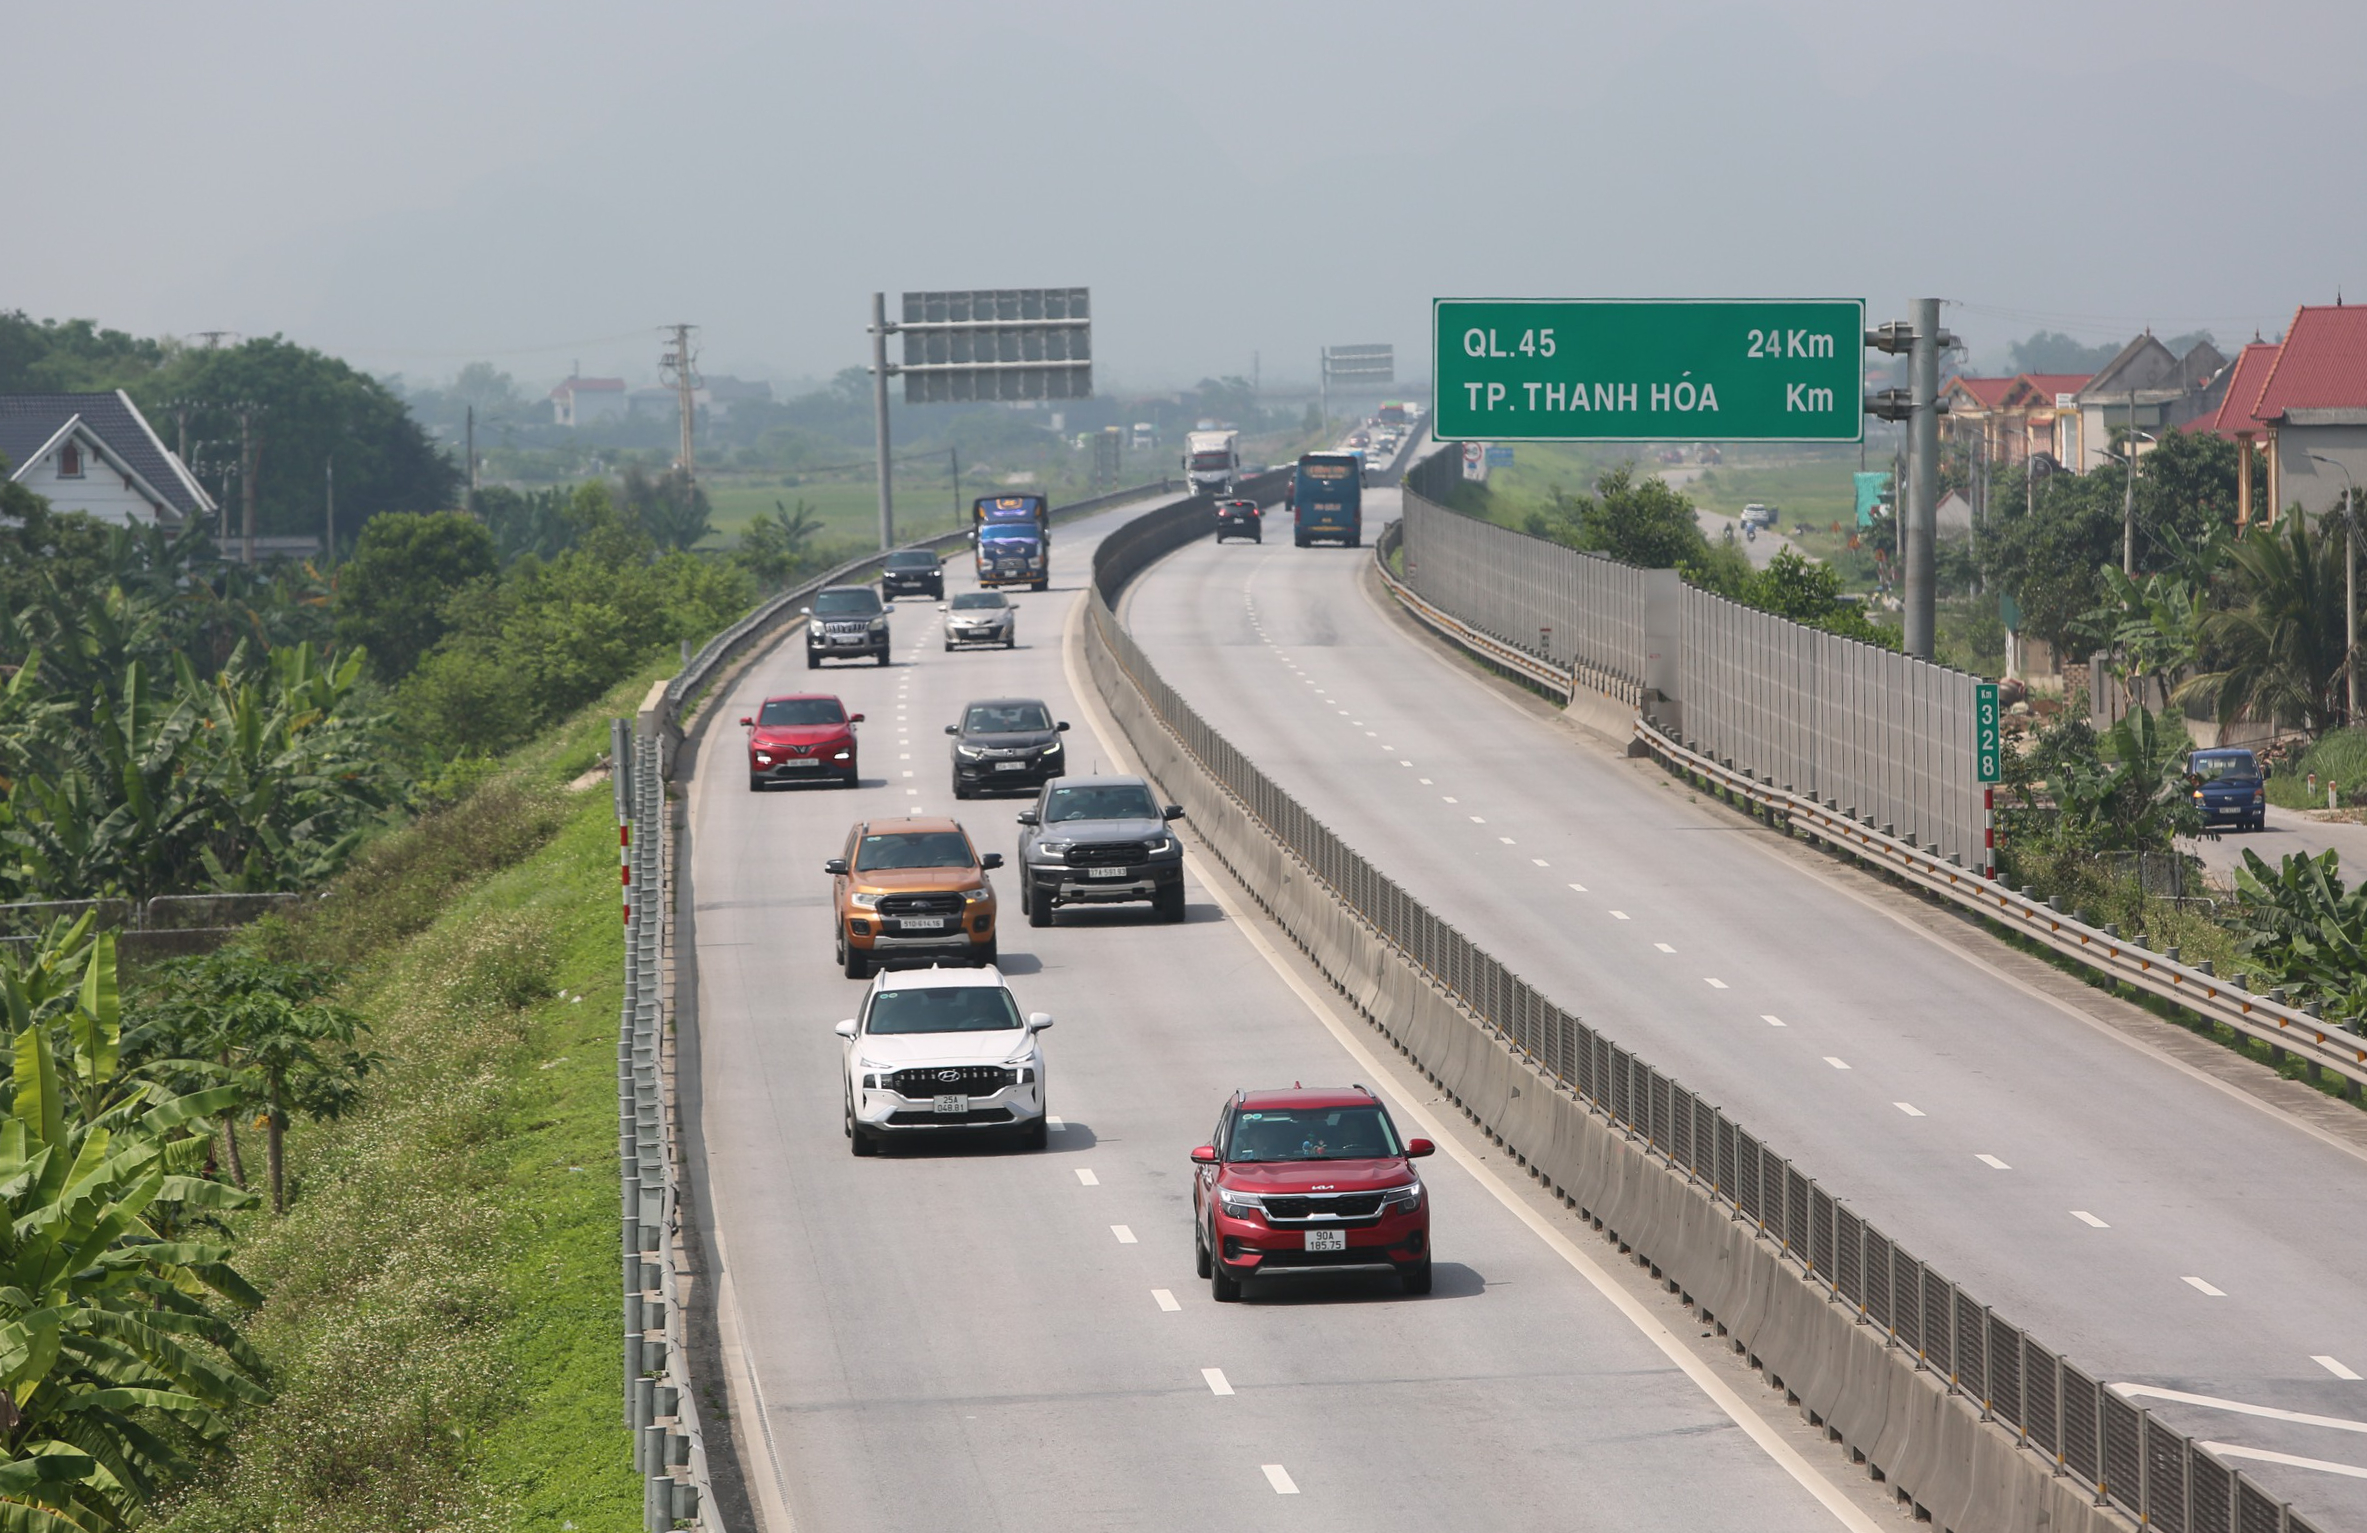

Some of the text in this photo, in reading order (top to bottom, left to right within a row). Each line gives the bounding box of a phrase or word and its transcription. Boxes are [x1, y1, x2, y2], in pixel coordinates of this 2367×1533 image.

[1463, 328, 1556, 358] QL.45
[1522, 381, 1638, 412] THANH
[1651, 370, 1719, 412] HÓA
[1786, 383, 1833, 412] Km
[1981, 689, 1992, 699] Km
[943, 1095, 958, 1104] 25A
[1316, 1231, 1334, 1240] 90A
[1310, 1240, 1342, 1250] 185.75
